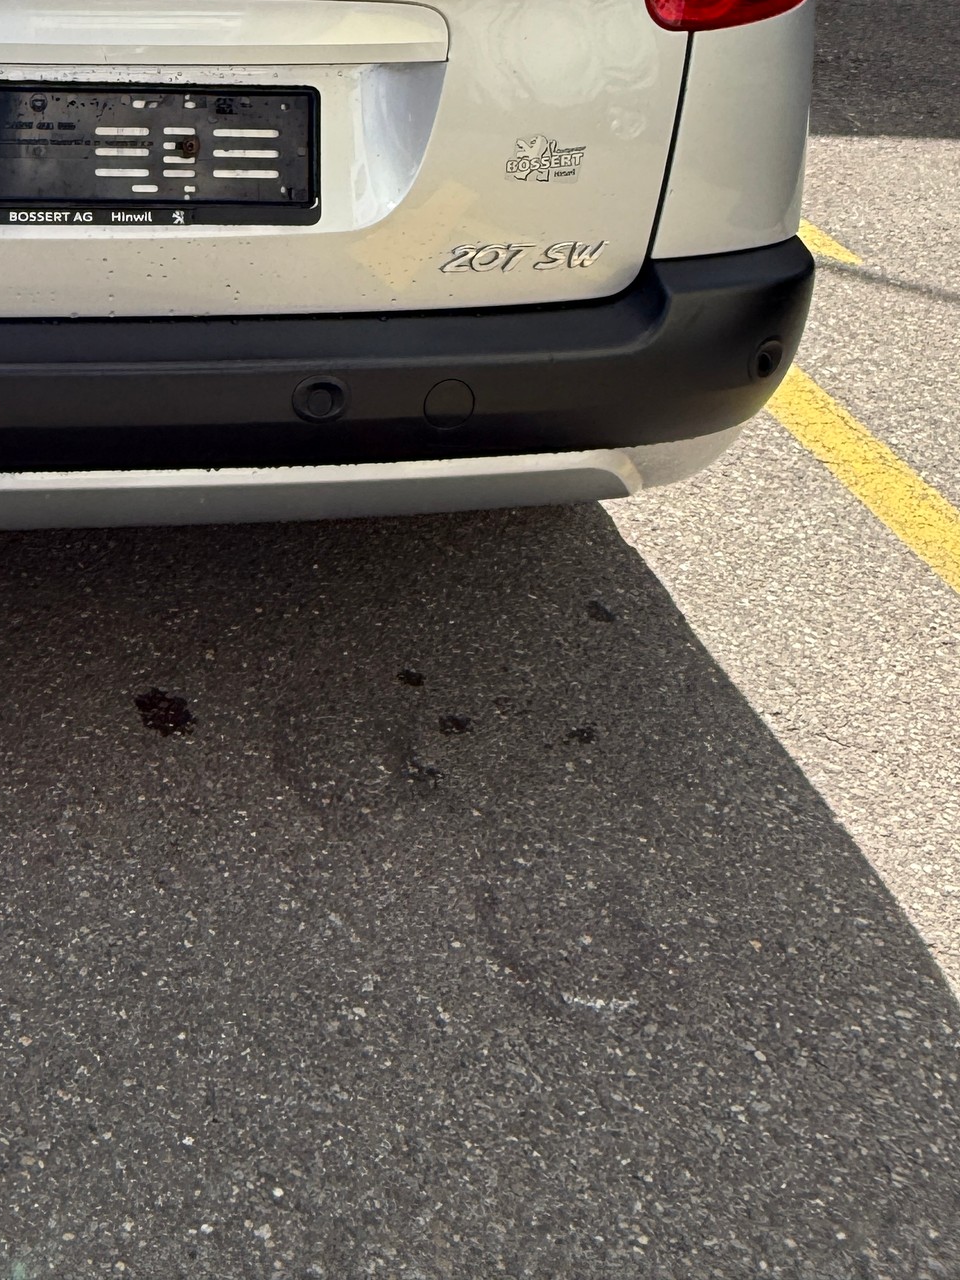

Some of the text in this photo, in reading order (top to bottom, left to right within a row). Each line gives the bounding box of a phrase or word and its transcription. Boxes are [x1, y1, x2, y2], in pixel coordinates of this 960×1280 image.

[505, 152, 584, 174] BOSSERT
[9, 211, 69, 222] BOSSERT
[73, 211, 93, 222] AG
[111, 211, 153, 222] Hinwil
[439, 240, 610, 273] 207 SW
